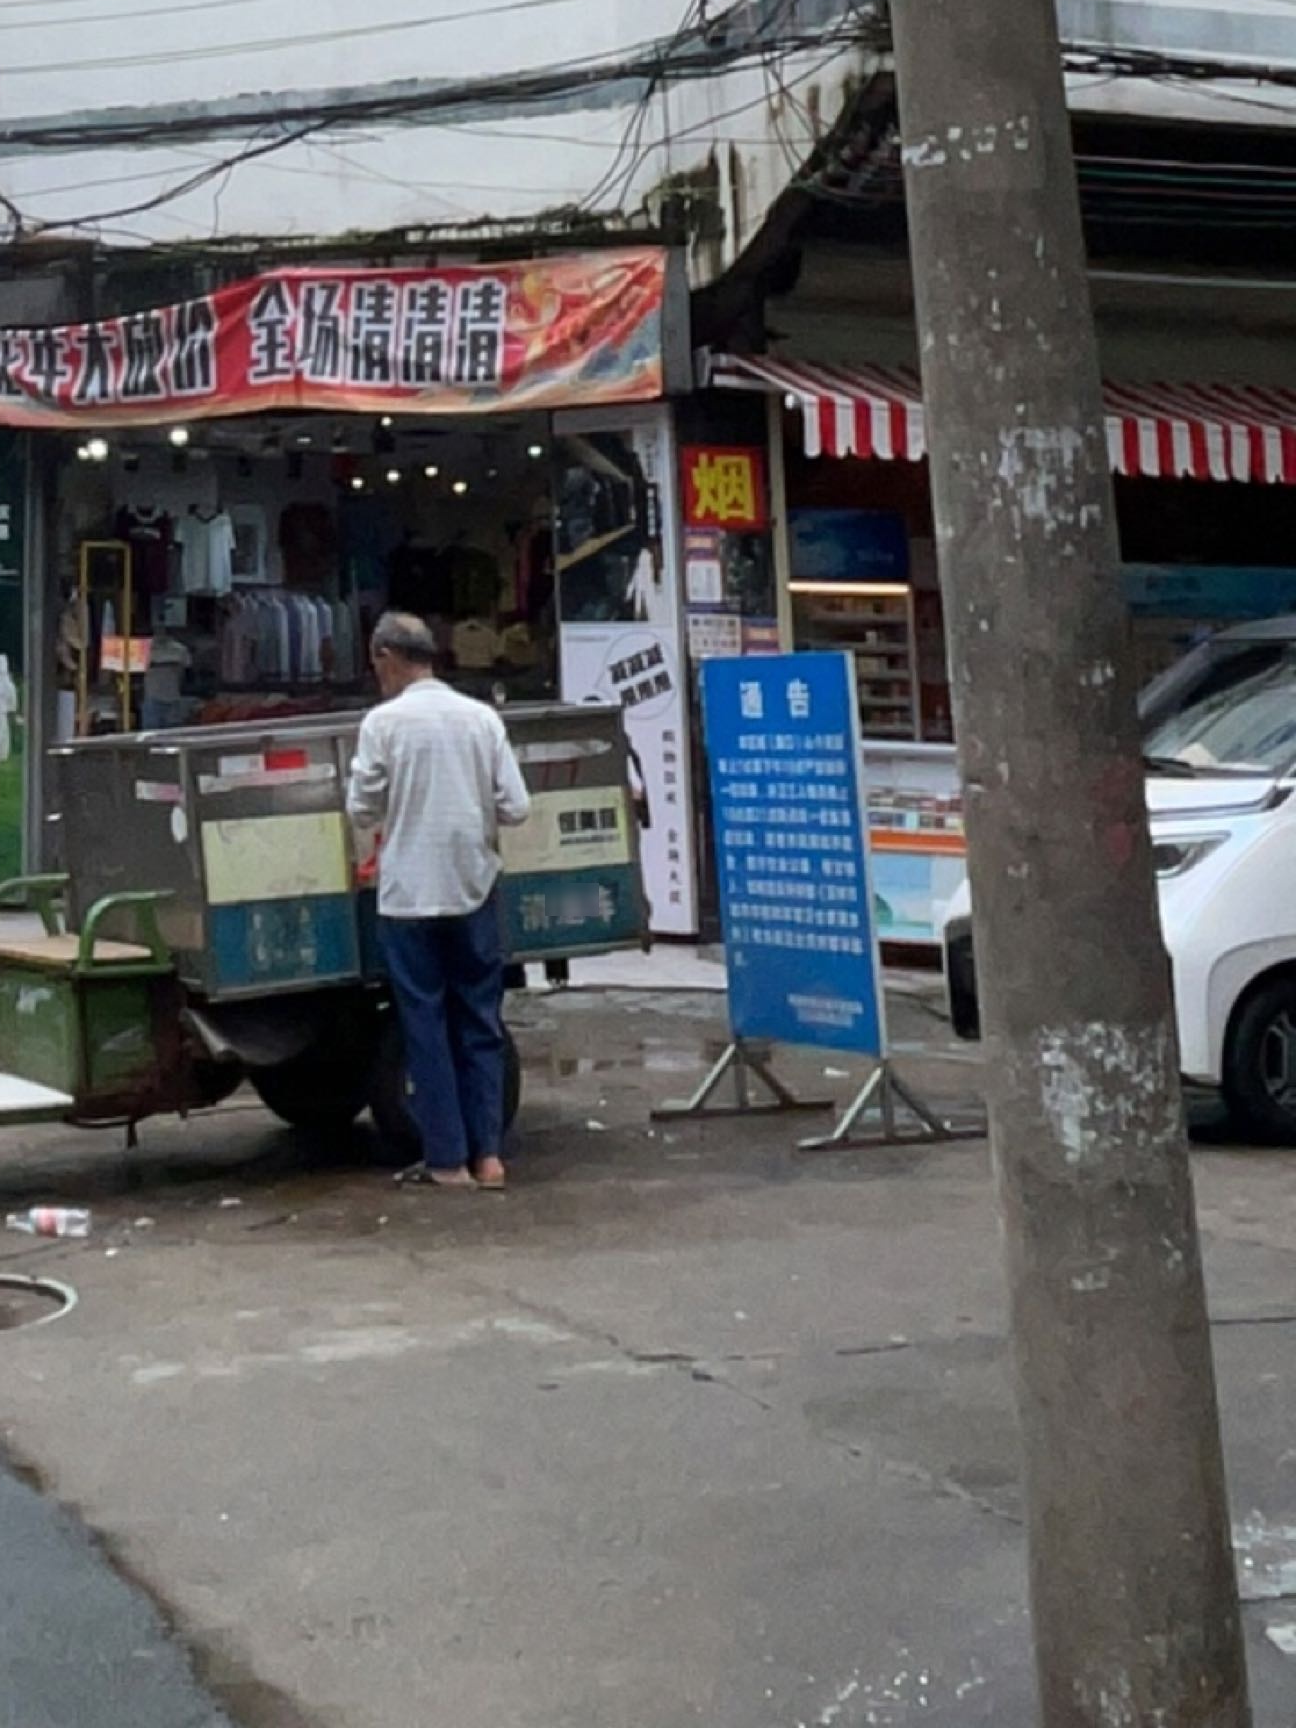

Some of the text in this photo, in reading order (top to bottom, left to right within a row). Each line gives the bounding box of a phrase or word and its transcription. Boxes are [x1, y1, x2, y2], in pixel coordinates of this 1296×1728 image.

[248, 277, 505, 385] 全场清清清
[691, 452, 755, 521] 烟
